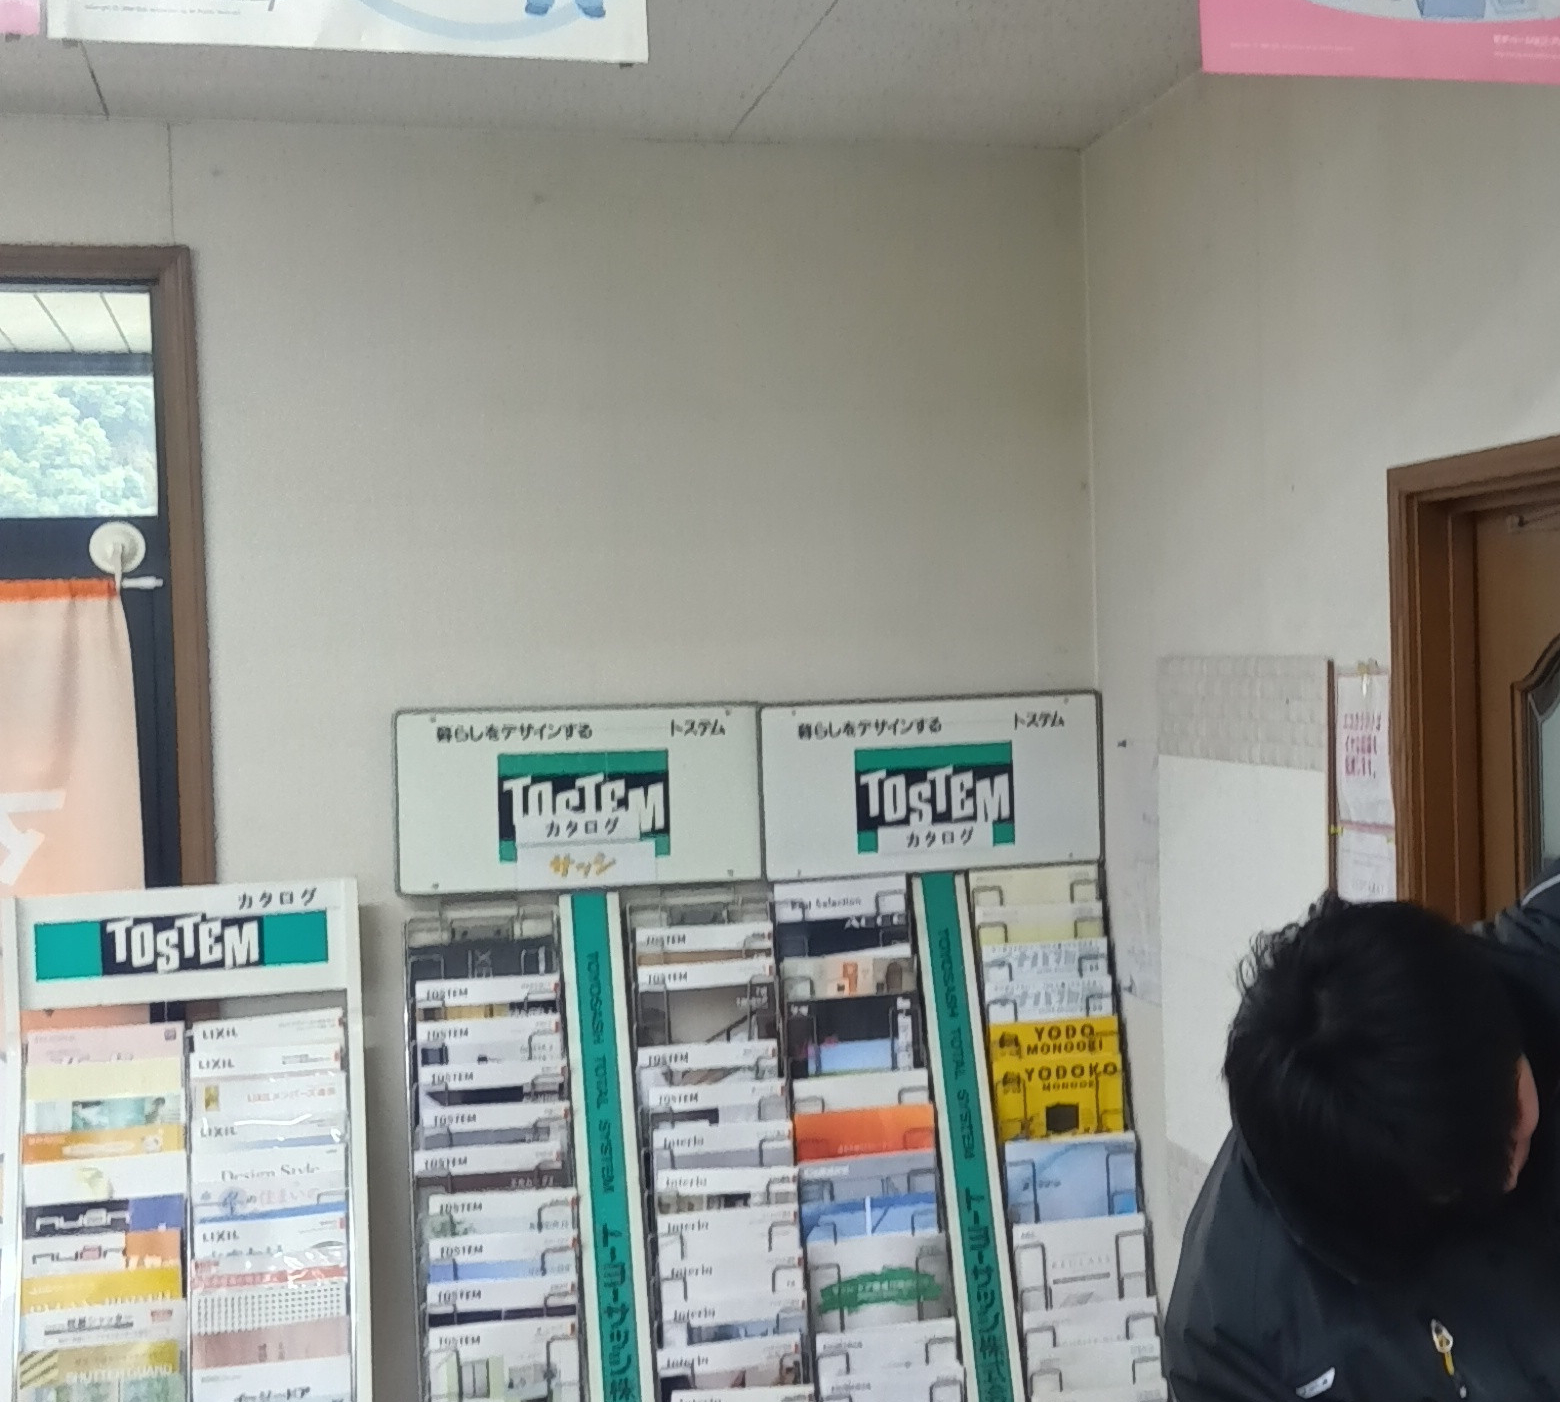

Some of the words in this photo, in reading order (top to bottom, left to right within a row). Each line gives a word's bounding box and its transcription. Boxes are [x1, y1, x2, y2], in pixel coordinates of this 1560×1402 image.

[671, 718, 727, 737] トステム
[1013, 711, 1065, 731] トステム
[860, 765, 1011, 826] TOSTEM
[546, 816, 619, 838] カタログ
[906, 826, 974, 848] カタログ
[237, 887, 318, 910] カタログ
[106, 913, 261, 973] TOSTEM
[202, 1027, 238, 1040] LIXIL
[1034, 1023, 1096, 1042] YODO
[198, 1058, 235, 1070] LIXIL
[1025, 1061, 1118, 1082] YODOKO
[202, 1229, 239, 1243] LIXIL
